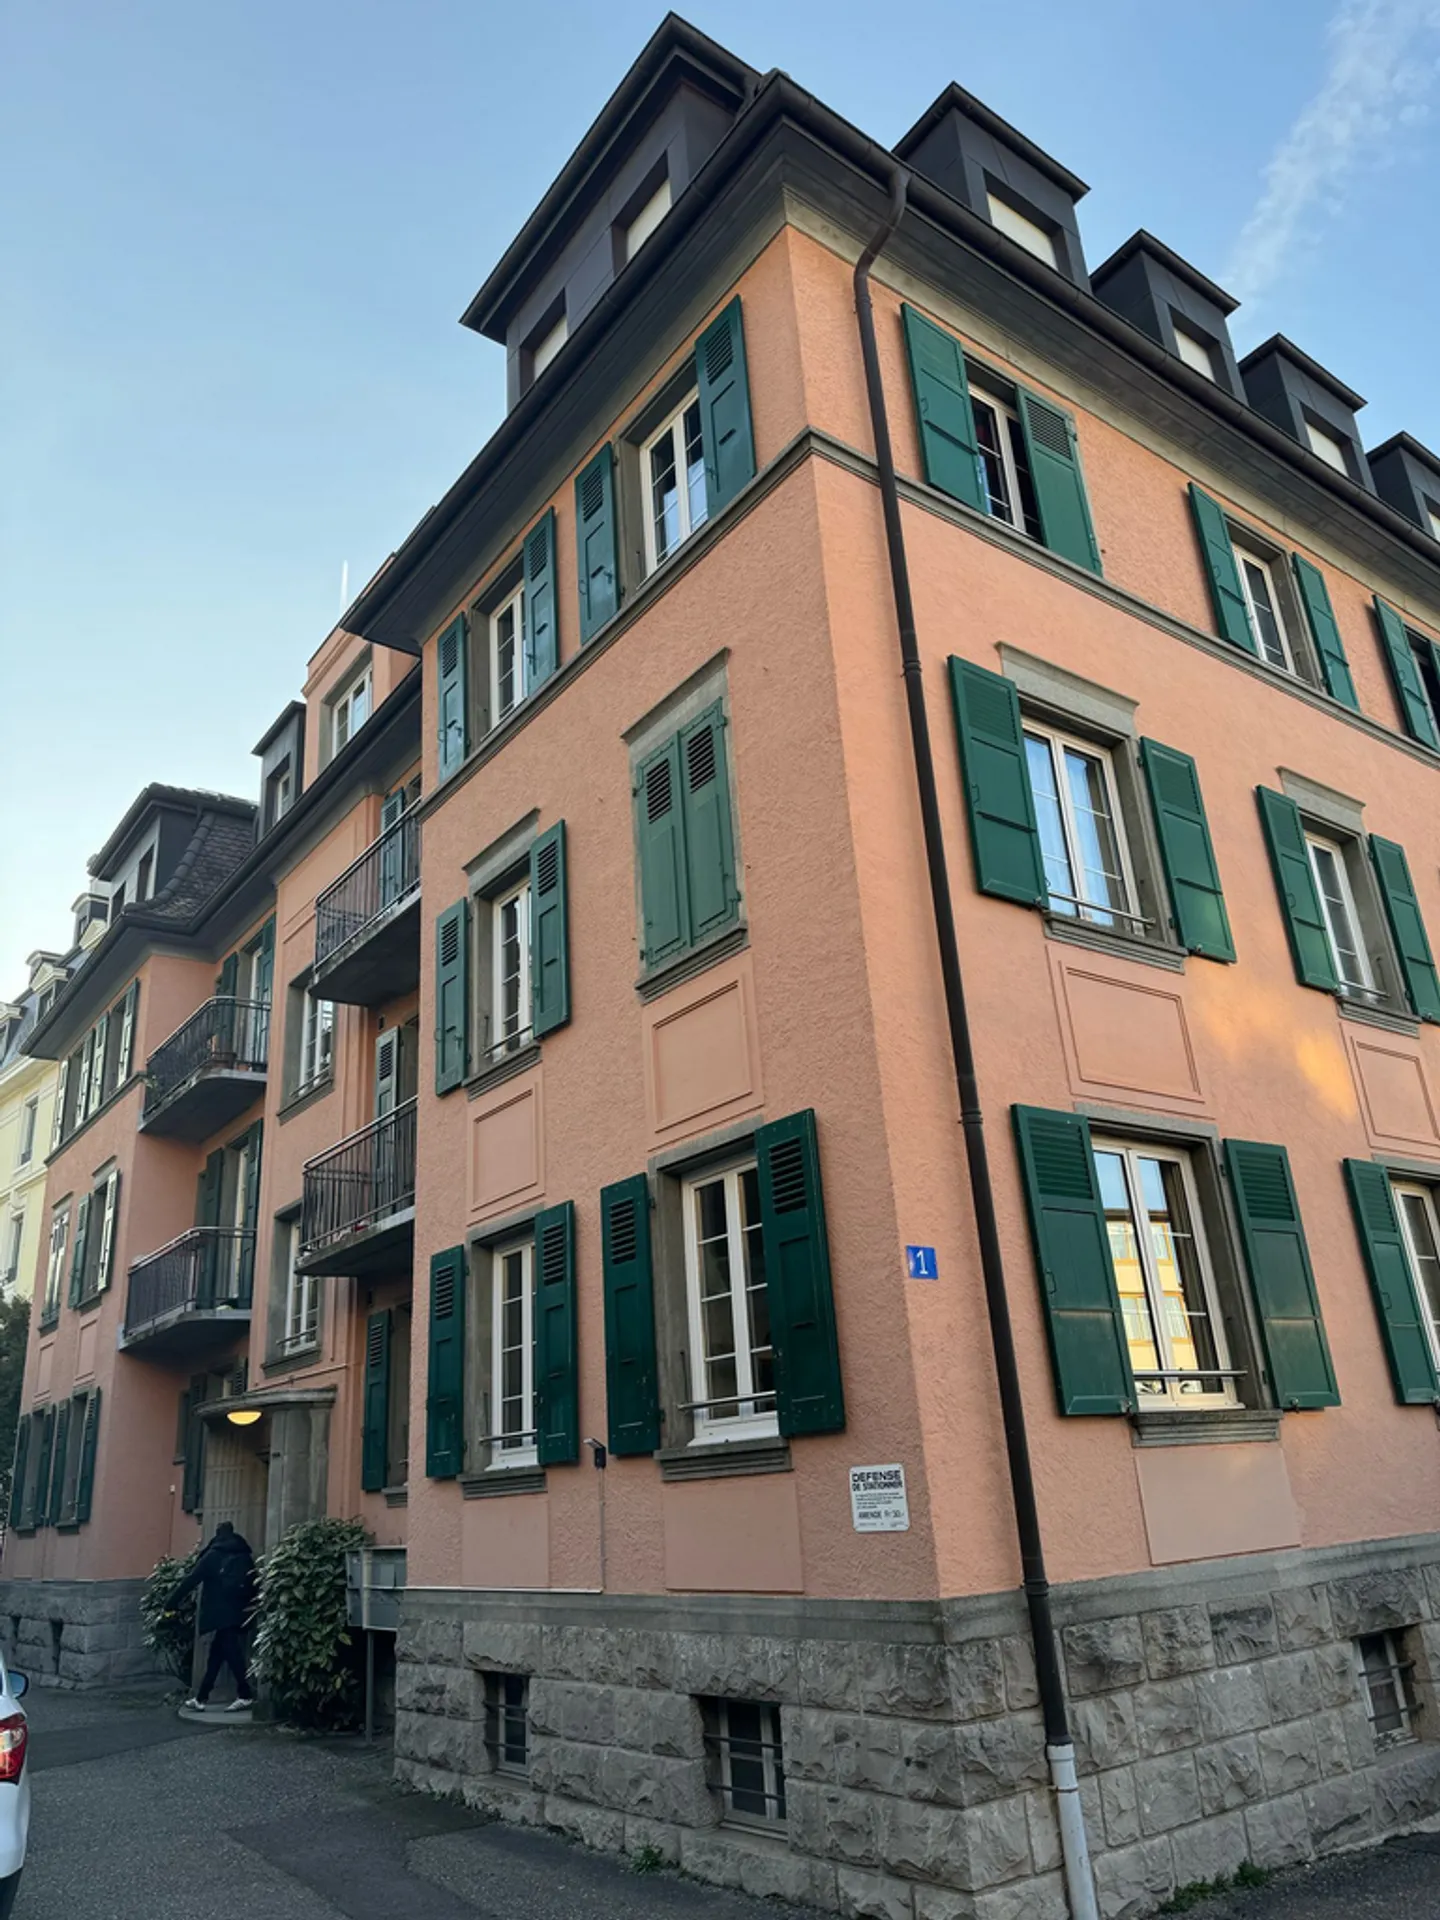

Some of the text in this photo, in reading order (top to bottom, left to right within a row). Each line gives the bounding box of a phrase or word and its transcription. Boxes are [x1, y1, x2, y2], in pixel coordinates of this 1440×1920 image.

[916, 1250, 928, 1275] 1
[852, 1470, 901, 1482] DEFENSE
[852, 1483, 861, 1492] DE
